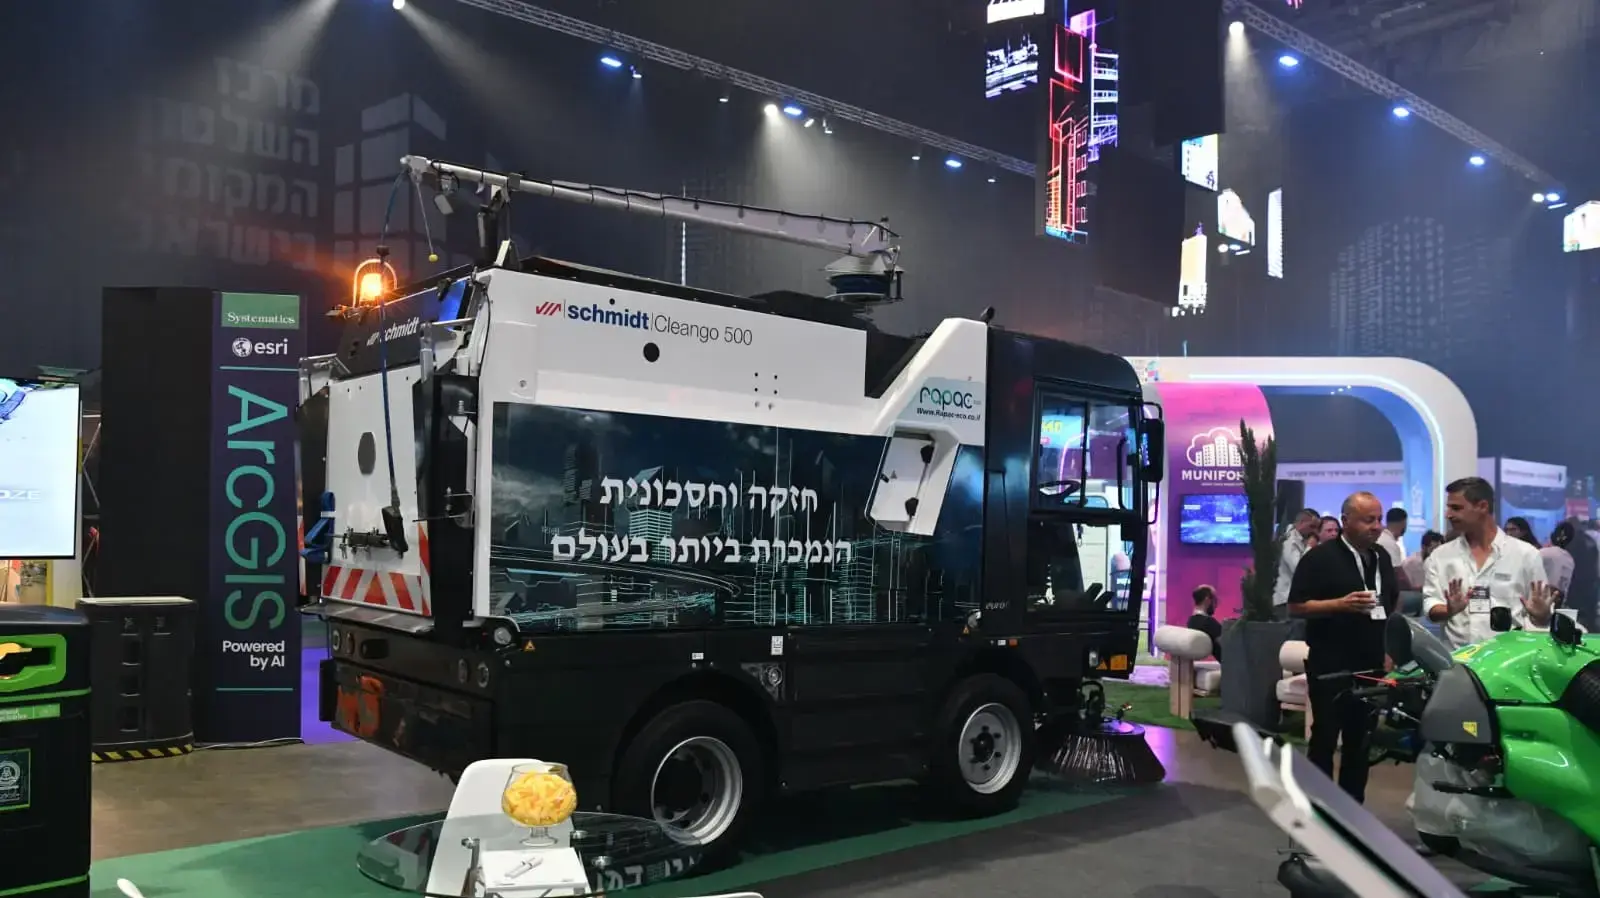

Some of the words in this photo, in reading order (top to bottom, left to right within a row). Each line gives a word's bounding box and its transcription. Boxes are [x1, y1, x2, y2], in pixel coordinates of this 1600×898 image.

[214, 57, 321, 115] מרכז
[227, 311, 296, 325] Systematics
[380, 316, 420, 344] chmidt
[567, 303, 650, 331] schmidt
[654, 314, 720, 344] Cleango
[723, 326, 754, 347] 500
[254, 338, 289, 355] esri
[919, 386, 974, 412] rapac
[599, 475, 738, 508] וחסכונית
[748, 481, 818, 518] חזקה
[224, 384, 289, 630] ArcGIS
[550, 526, 650, 563] בעולם
[659, 535, 742, 563] ביותר
[750, 536, 852, 564] הנמכרת
[222, 639, 286, 654] Powered
[250, 655, 267, 671] by
[270, 654, 286, 668] AI
